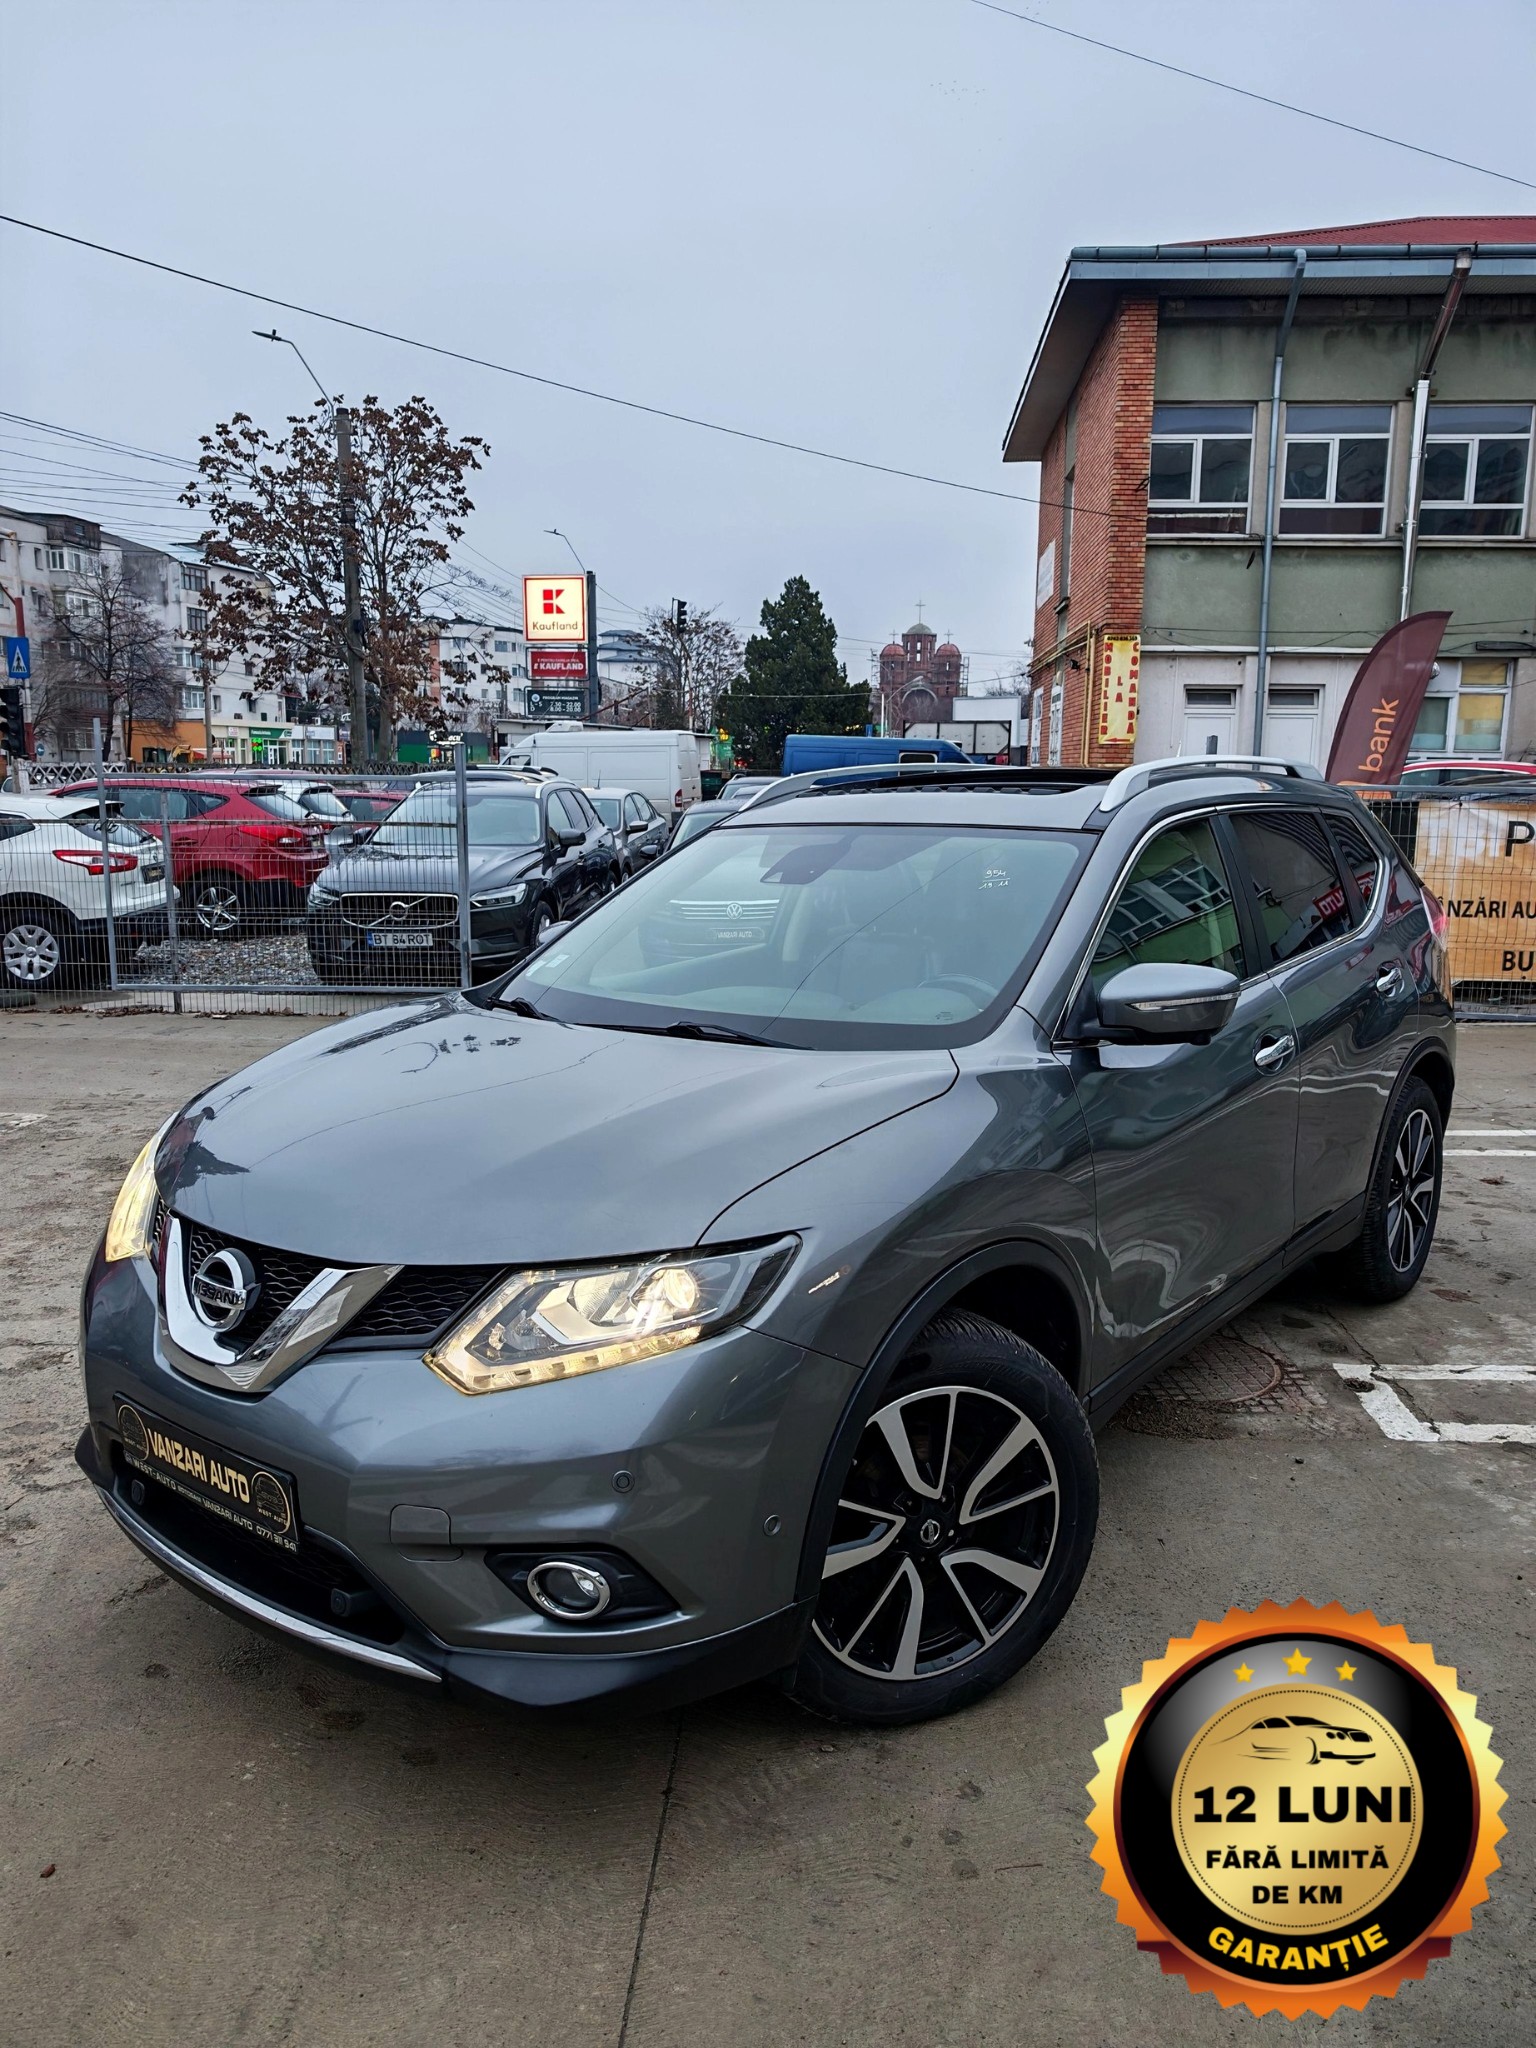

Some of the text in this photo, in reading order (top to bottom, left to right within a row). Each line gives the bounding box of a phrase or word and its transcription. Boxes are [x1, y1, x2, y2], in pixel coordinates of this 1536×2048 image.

[532, 621, 578, 631] Kaufland
[540, 662, 584, 670] KAUFLAND
[1100, 642, 1114, 735] MOBILIER
[1115, 676, 1124, 703] LA
[1126, 642, 1140, 734] COMANDA
[1358, 698, 1400, 772] bank
[373, 934, 388, 945] BT
[407, 934, 430, 945] ROT
[132, 1459, 177, 1491] WEST-AUTO
[202, 1498, 232, 1521] VANZARI
[233, 1515, 253, 1531] AUTO
[147, 1427, 250, 1504] VANZARI AUTO
